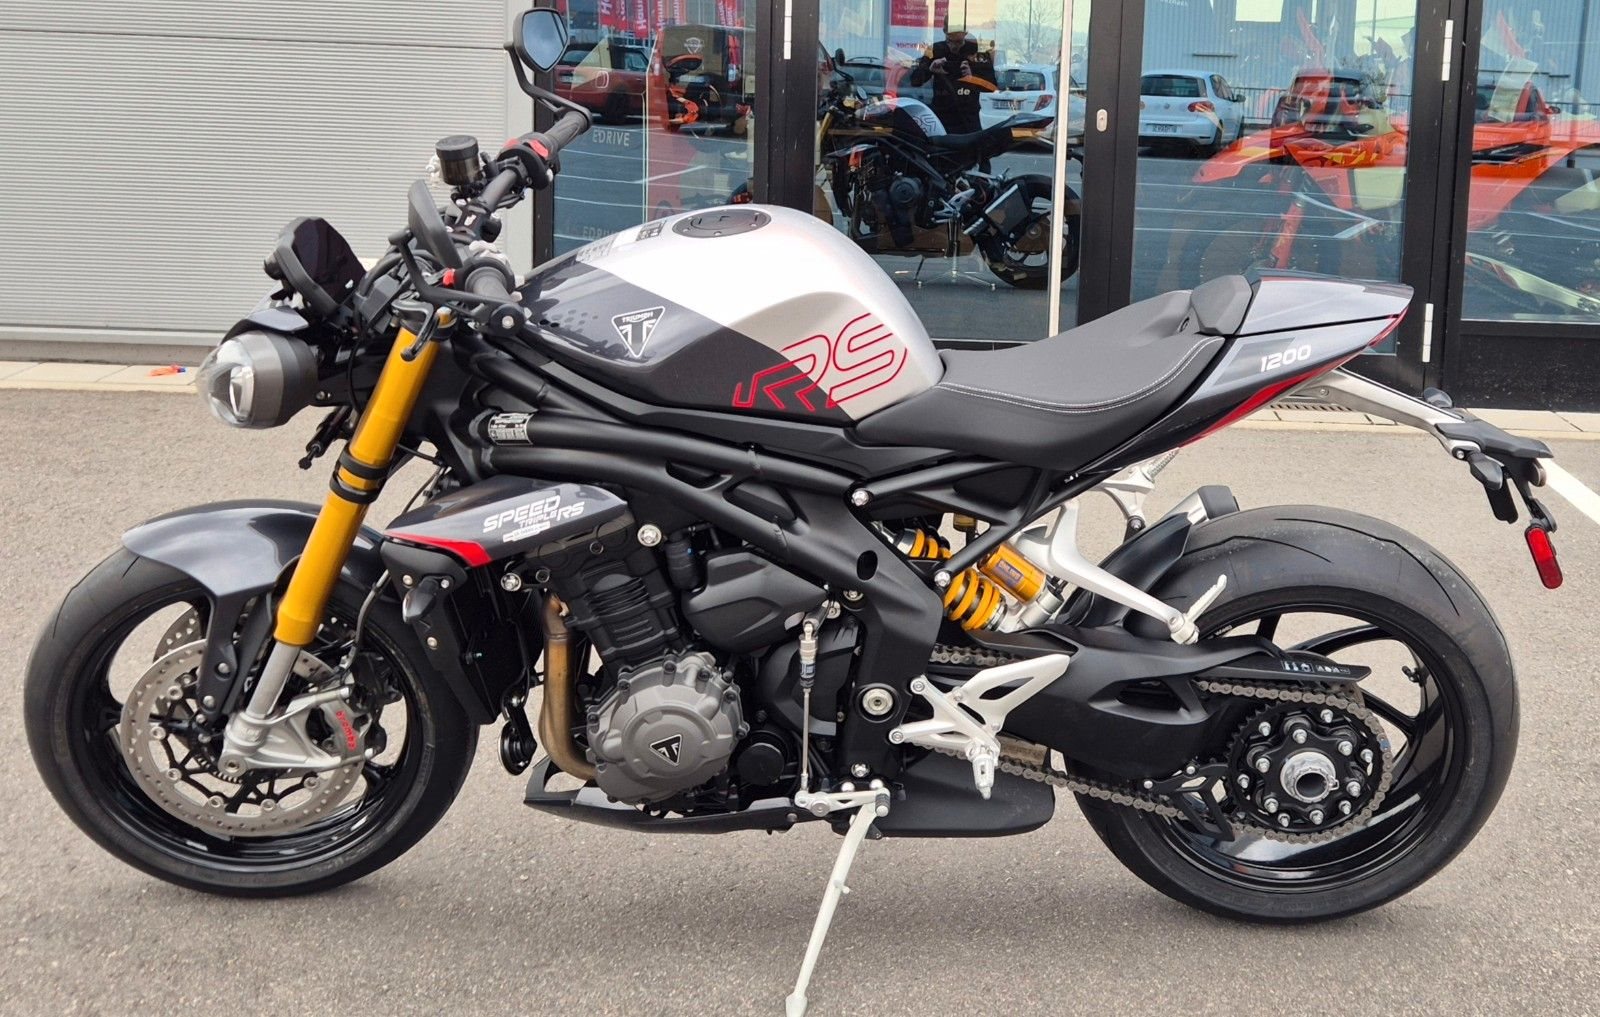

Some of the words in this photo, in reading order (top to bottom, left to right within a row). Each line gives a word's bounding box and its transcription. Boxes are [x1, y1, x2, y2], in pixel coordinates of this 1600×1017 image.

[621, 311, 654, 323] TRIUMPH
[732, 312, 908, 412] RS
[1260, 344, 1312, 373] 1200
[482, 494, 561, 534] SPEED
[556, 501, 585, 522] RS
